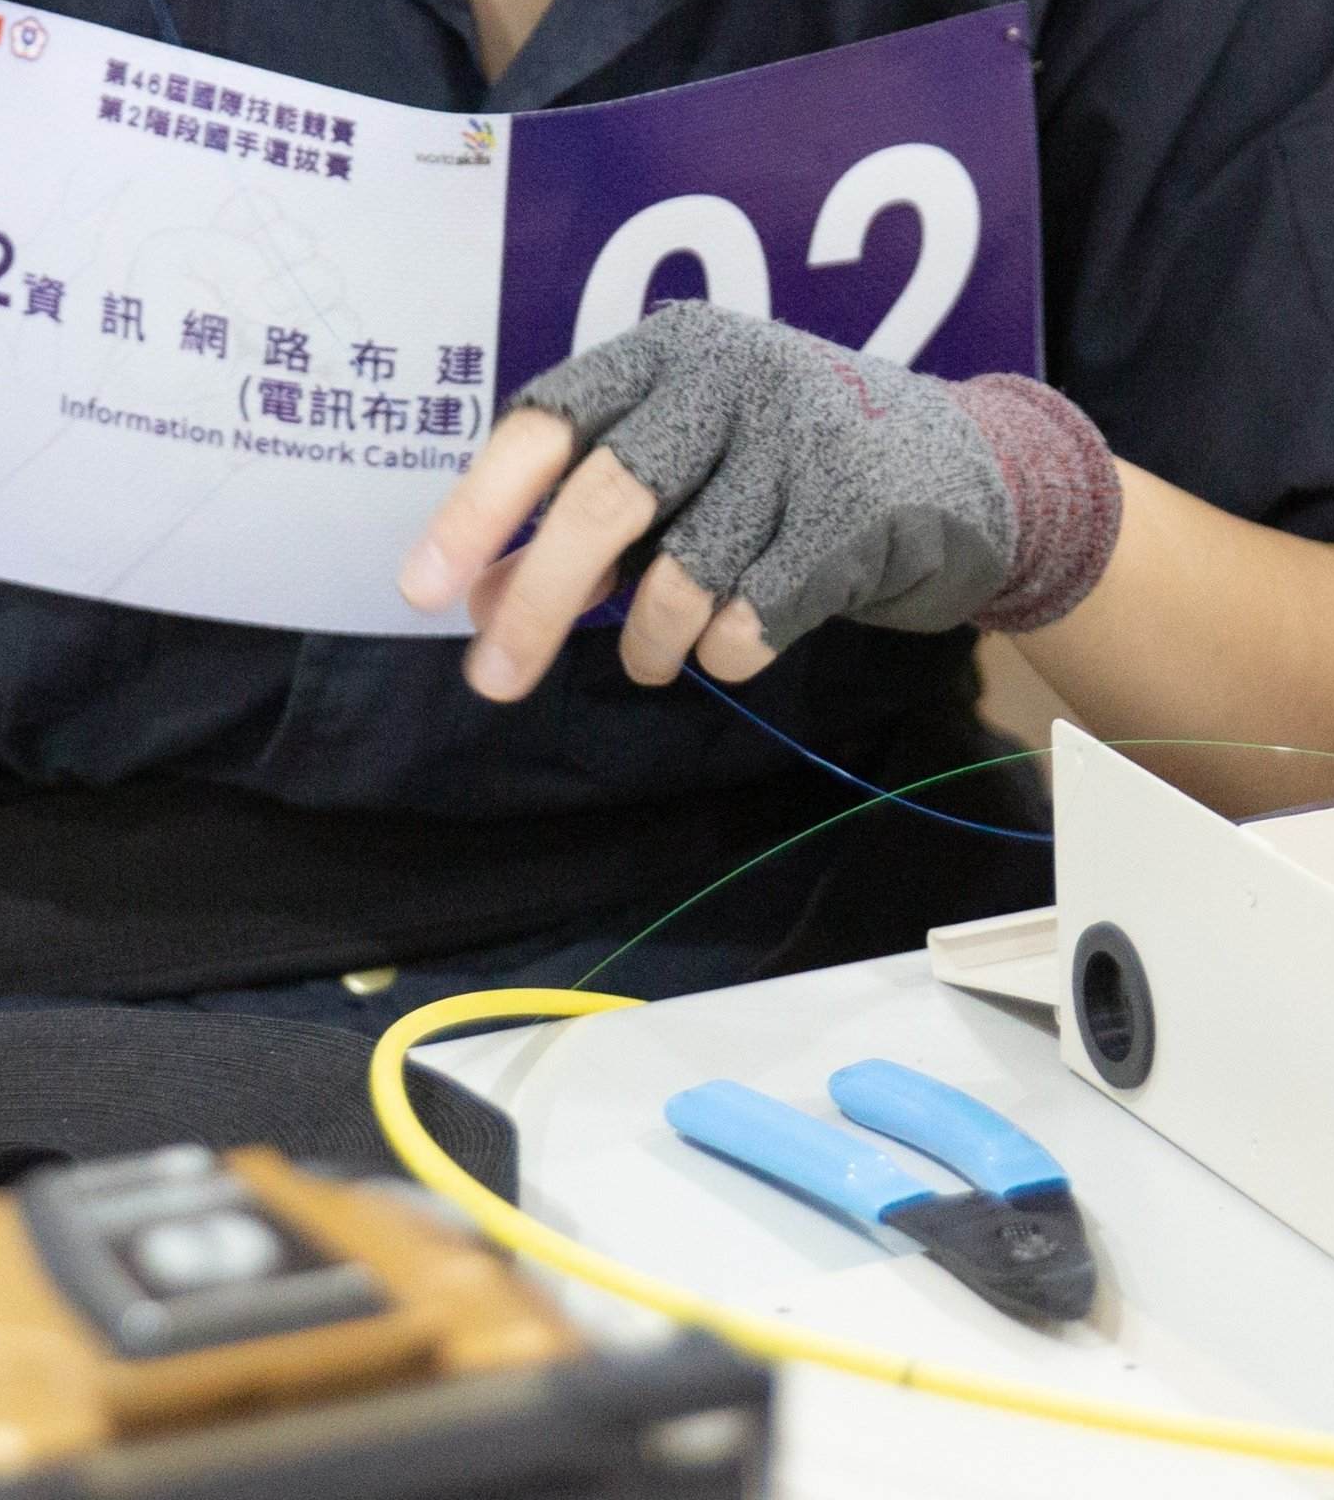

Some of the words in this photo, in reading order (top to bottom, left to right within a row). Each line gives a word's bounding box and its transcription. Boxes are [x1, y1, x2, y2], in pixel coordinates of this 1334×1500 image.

[59, 393, 224, 448] Information
[231, 429, 354, 465] Network
[364, 445, 473, 475] Cabling
[238, 375, 482, 441] (電訊布建)
